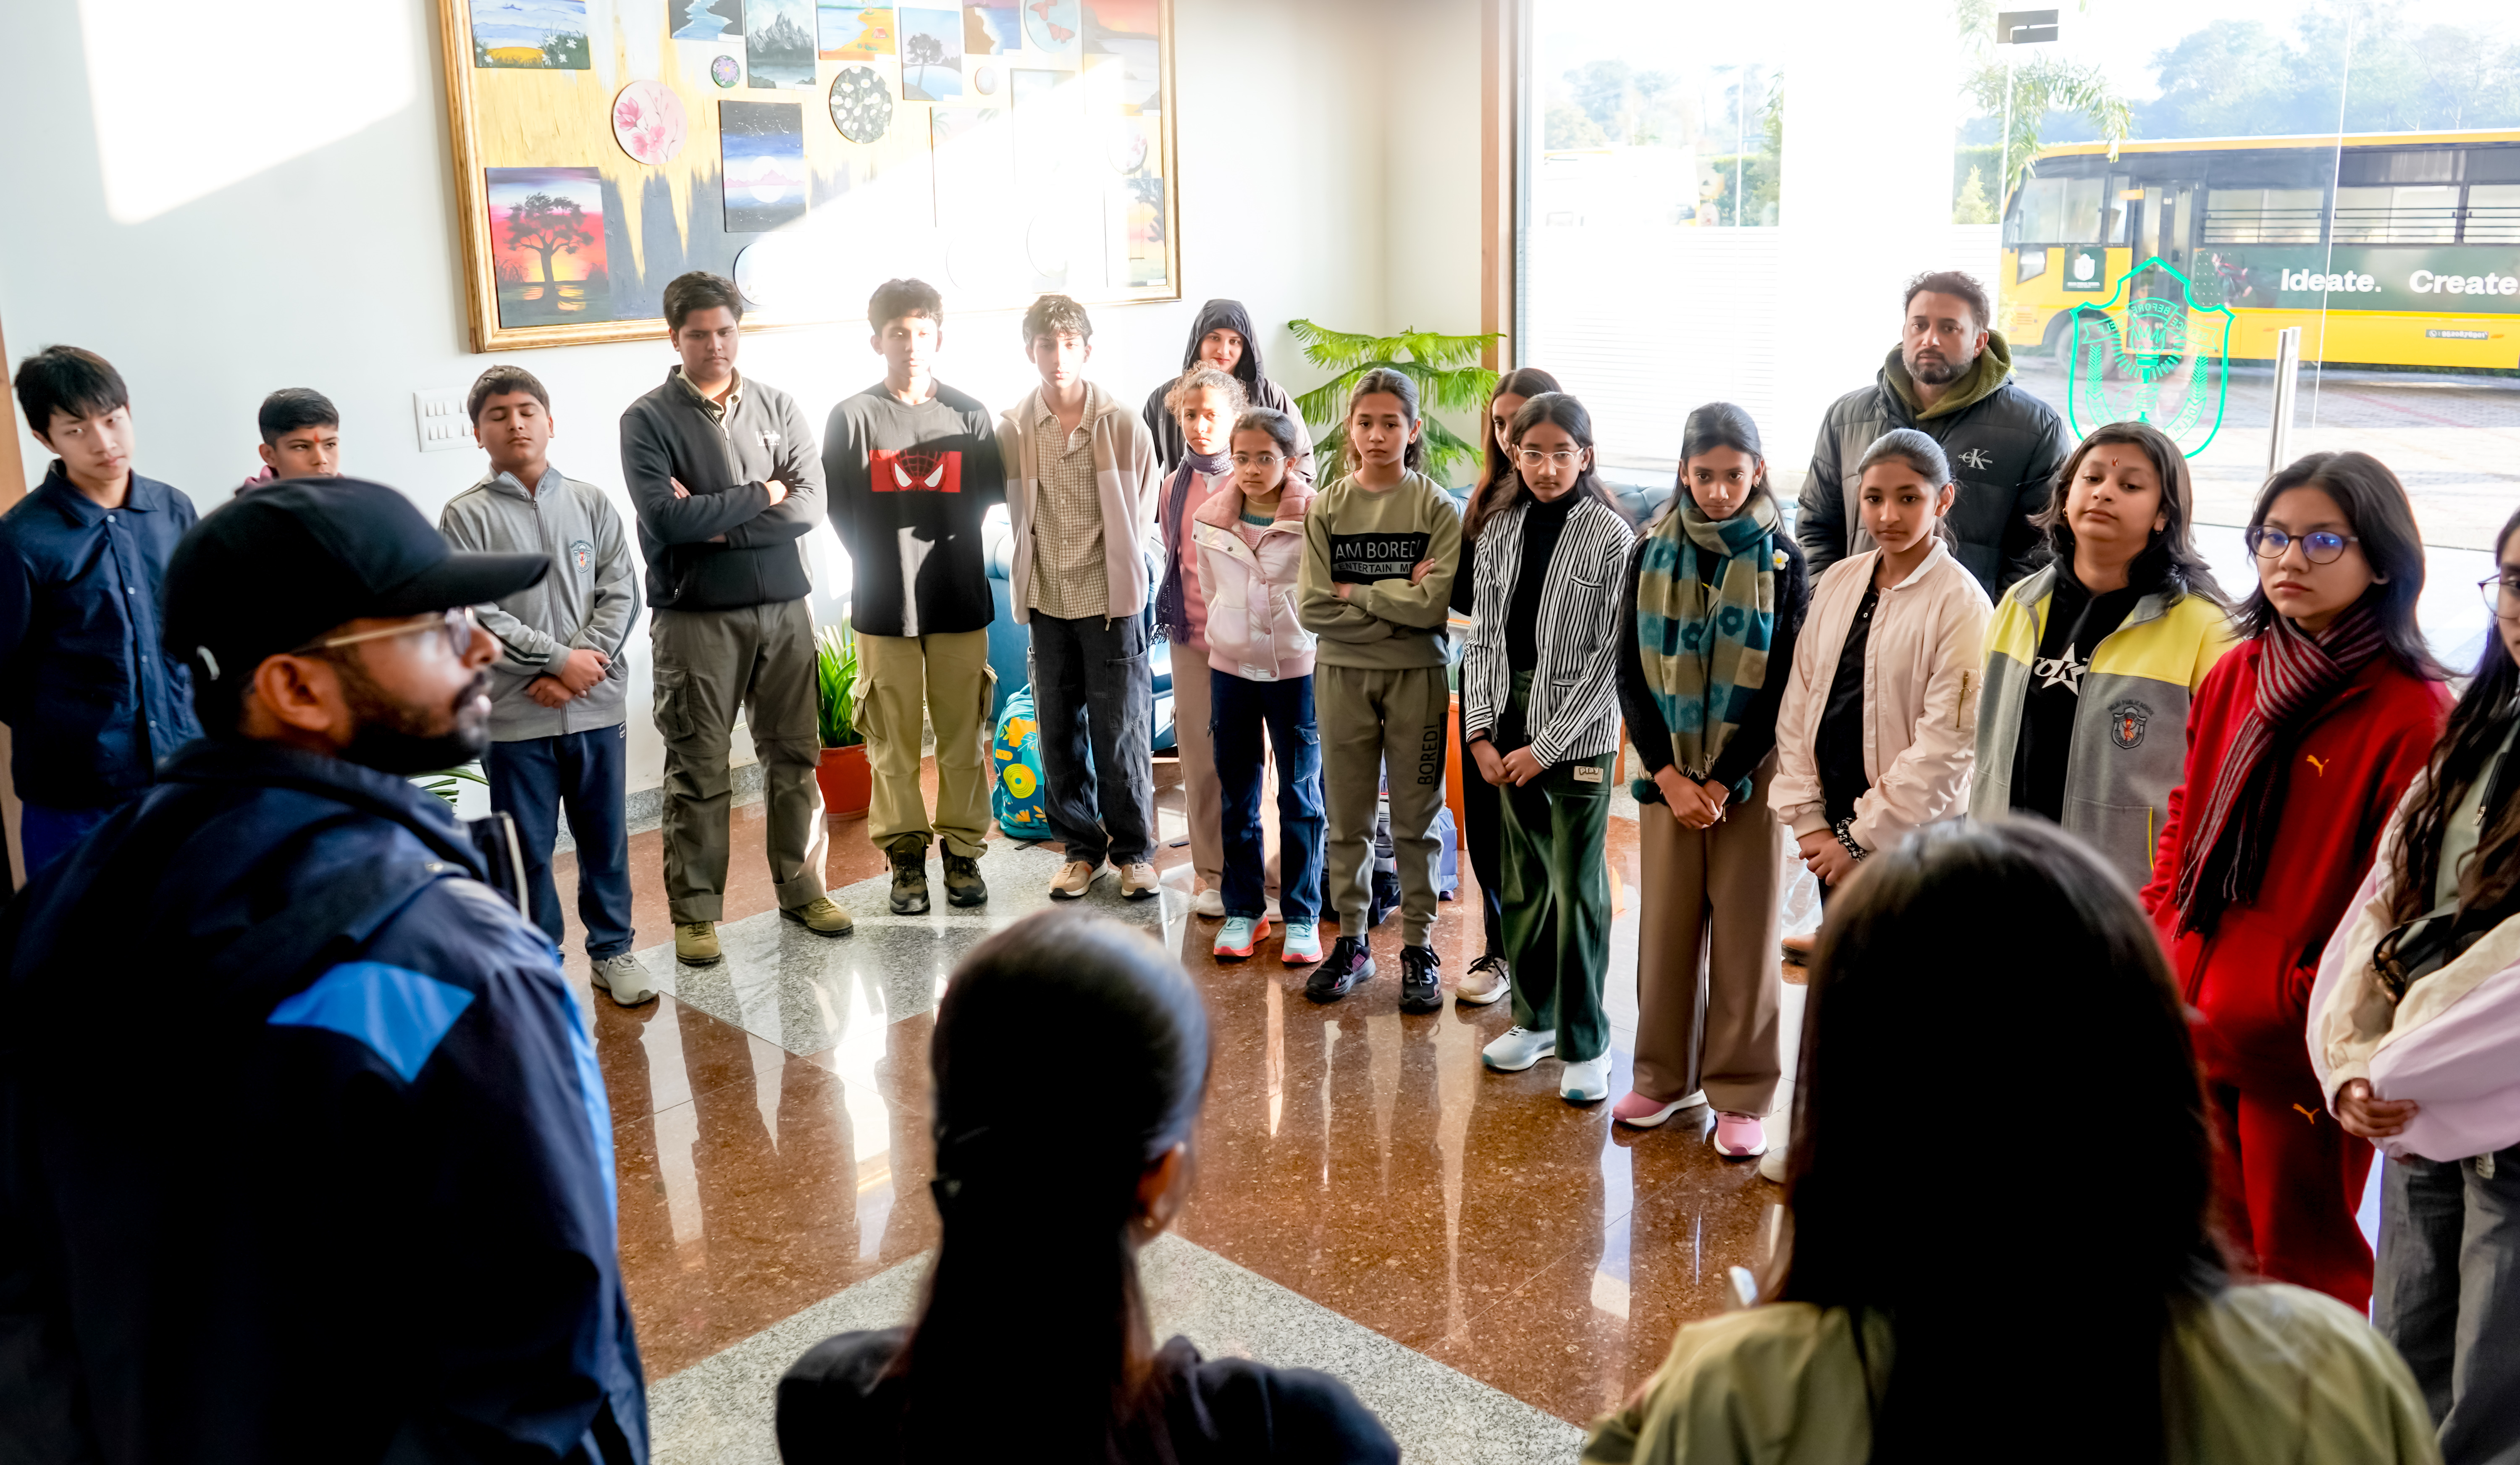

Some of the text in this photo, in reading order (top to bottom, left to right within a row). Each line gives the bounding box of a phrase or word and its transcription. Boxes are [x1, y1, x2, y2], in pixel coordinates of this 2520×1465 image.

[2281, 268, 2520, 295] Ideate. Create
[1336, 542, 1362, 559] AM
[1339, 562, 1392, 573] ENTERTAIN
[1417, 724, 1438, 785] BORED!
